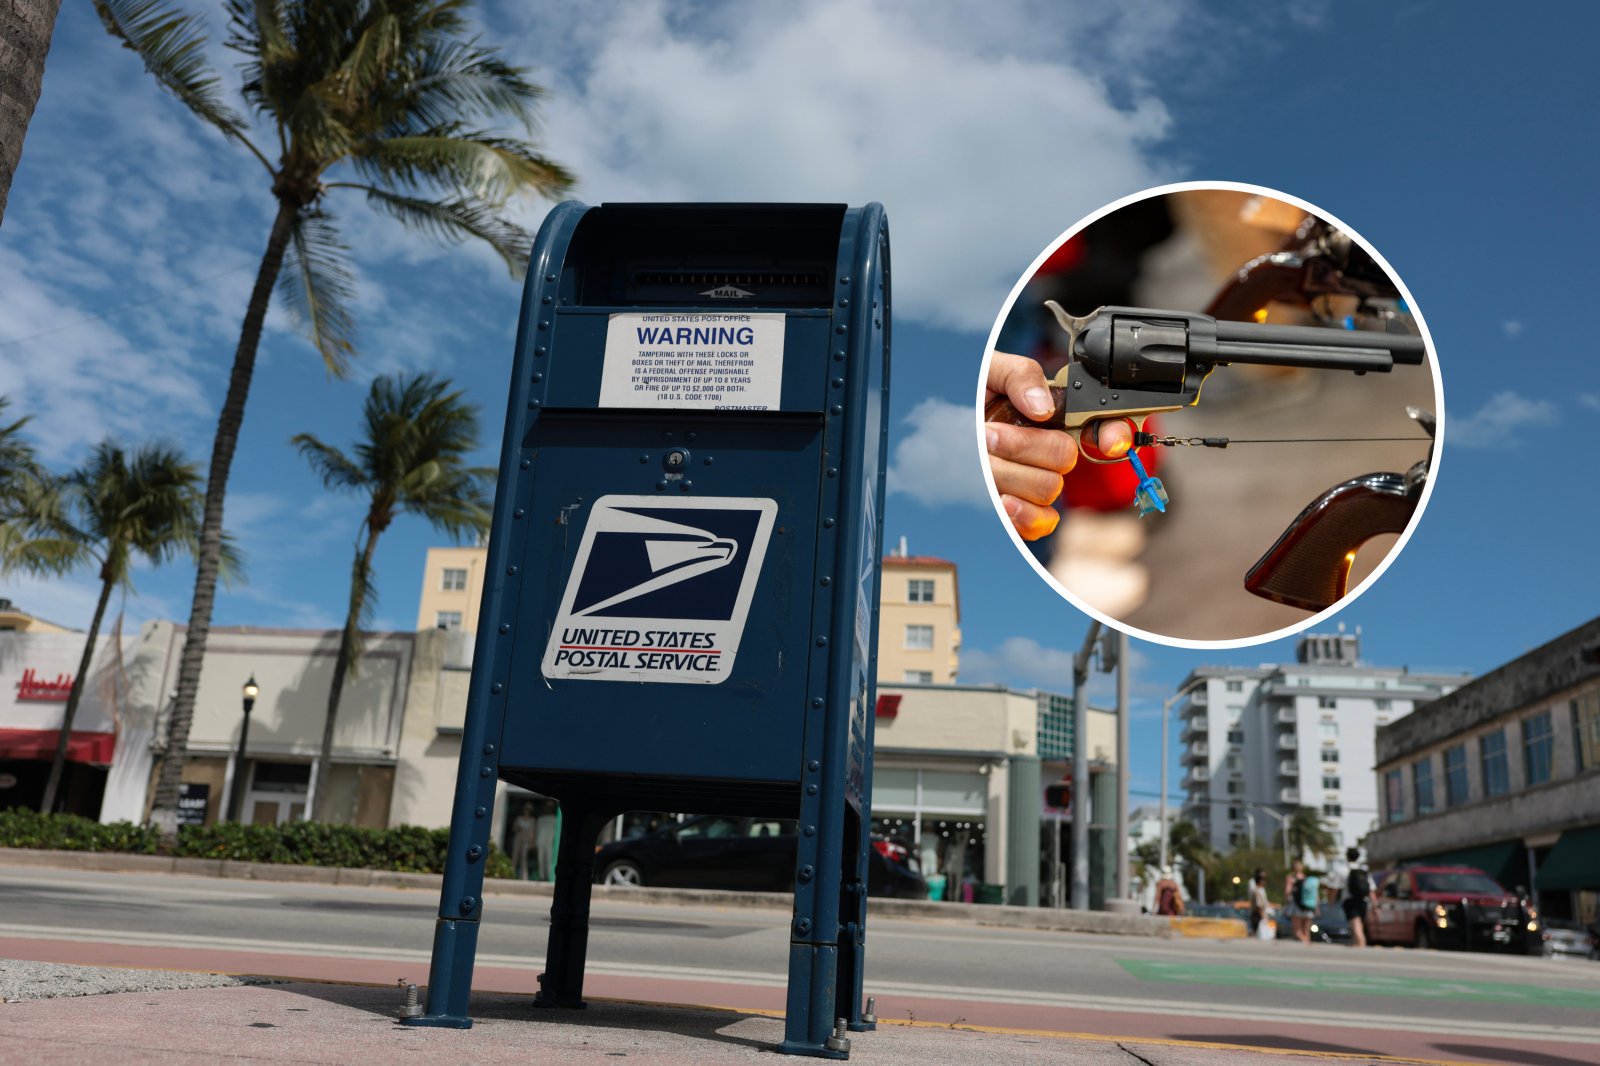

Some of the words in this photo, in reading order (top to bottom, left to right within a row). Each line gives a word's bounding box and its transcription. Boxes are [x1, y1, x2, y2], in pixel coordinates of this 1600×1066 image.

[714, 290, 740, 298] MAIL
[636, 327, 754, 345] WARNING
[561, 628, 640, 646] UNITED
[642, 630, 716, 648] STATES
[554, 650, 631, 668] POSTAL
[634, 652, 721, 672] SERVICE
